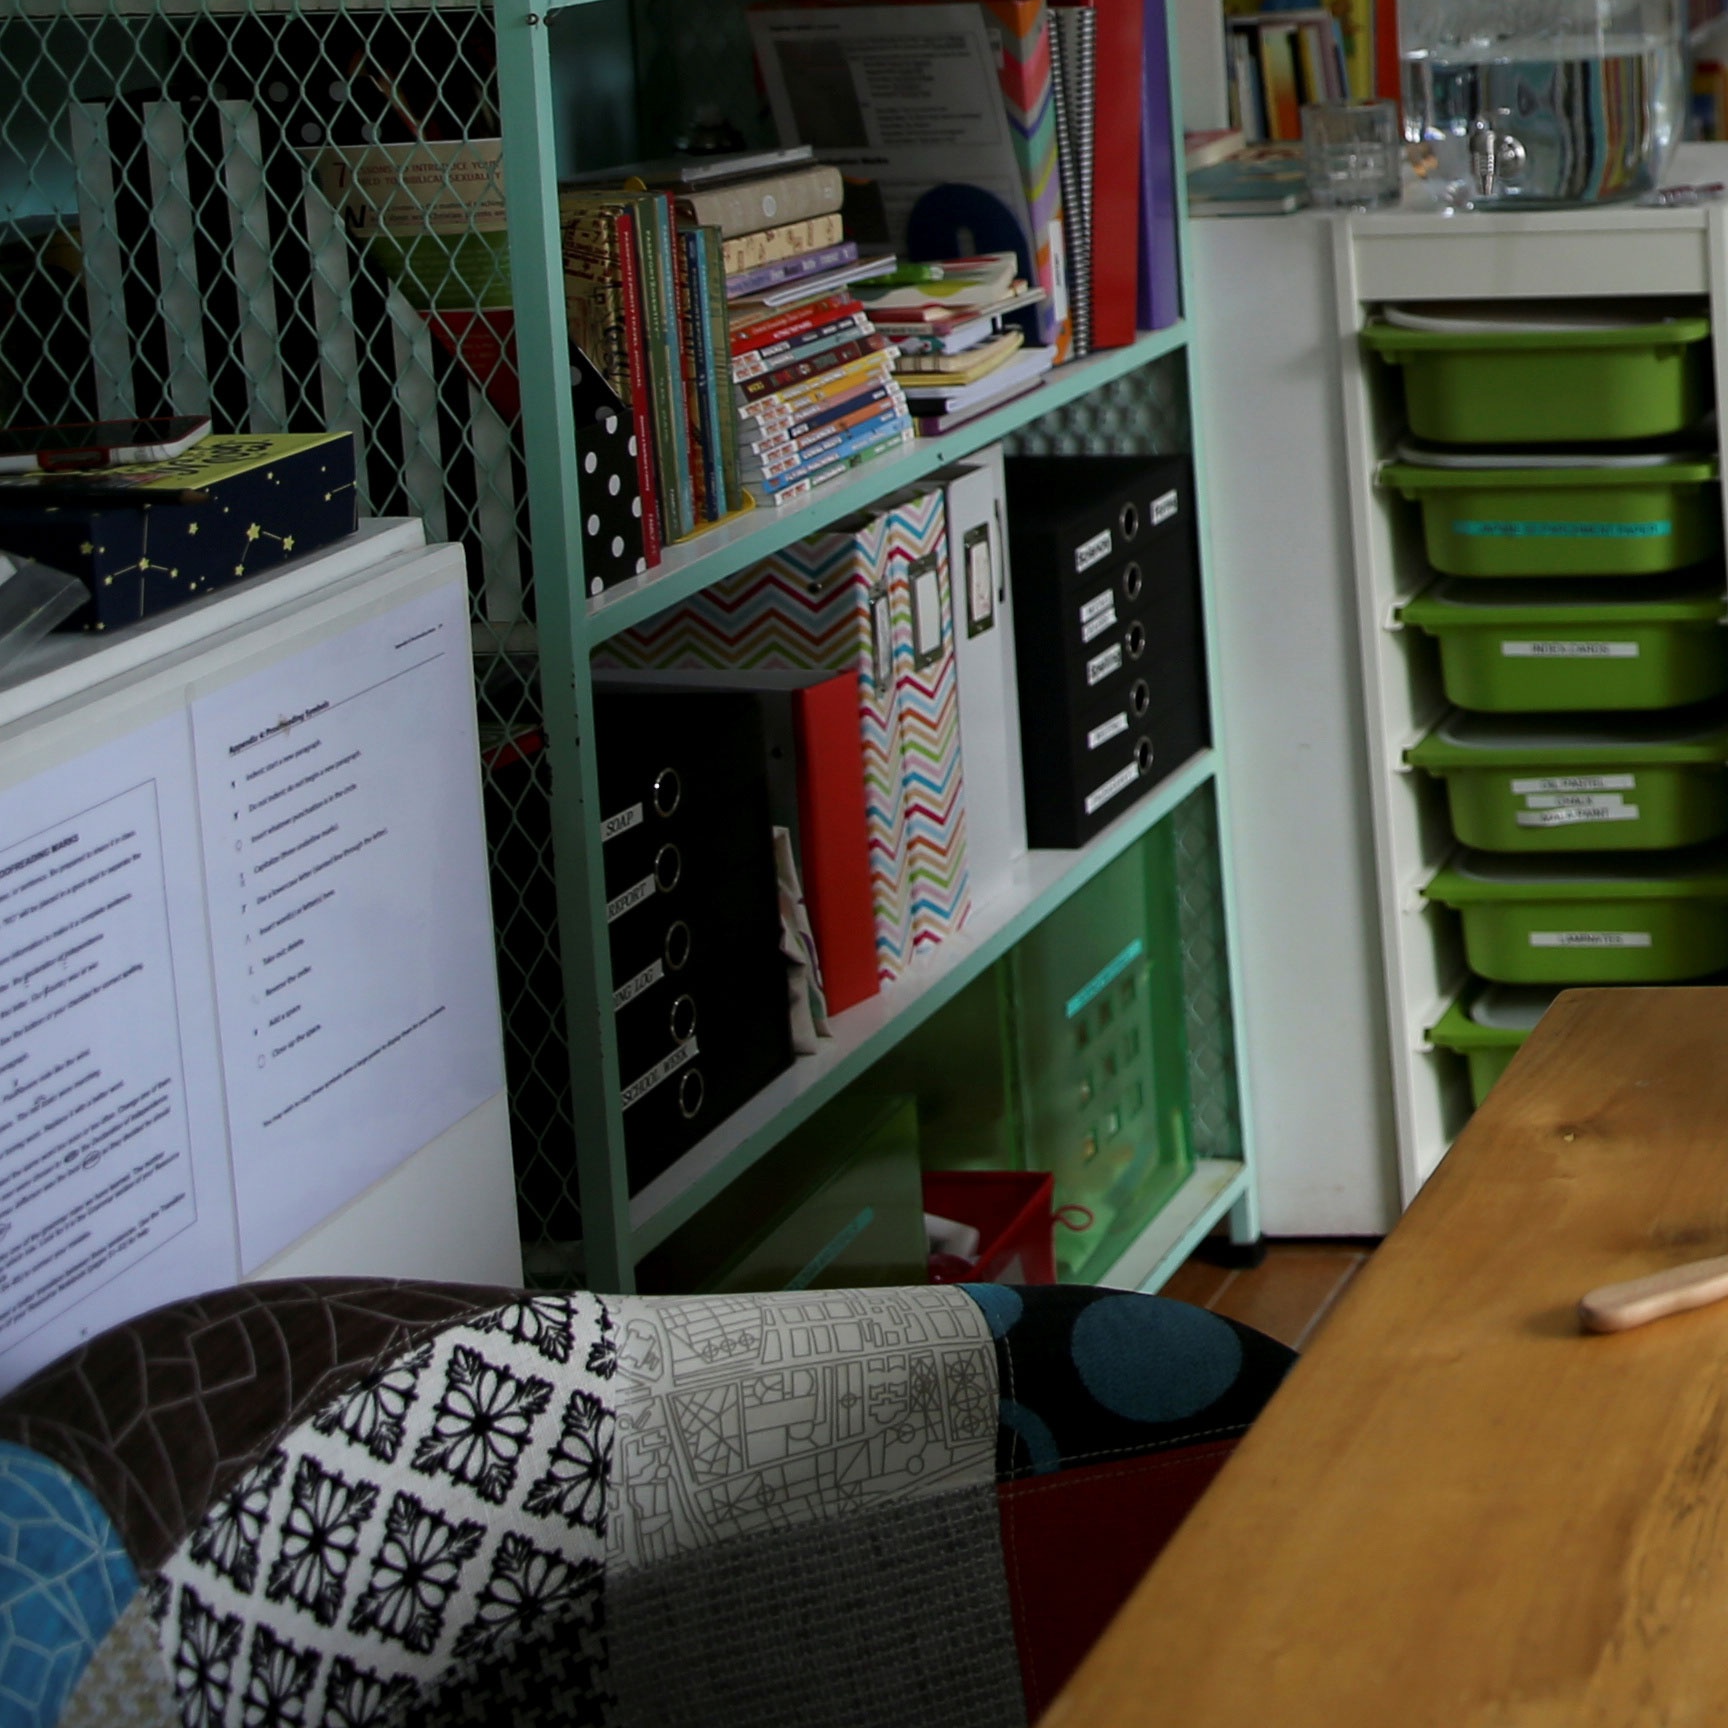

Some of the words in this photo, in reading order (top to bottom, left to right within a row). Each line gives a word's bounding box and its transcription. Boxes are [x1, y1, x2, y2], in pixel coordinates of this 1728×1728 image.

[606, 811, 634, 837] SOAP
[607, 883, 648, 918] REPORT
[631, 973, 652, 992] LOG
[622, 1073, 658, 1104] SCHOOL
